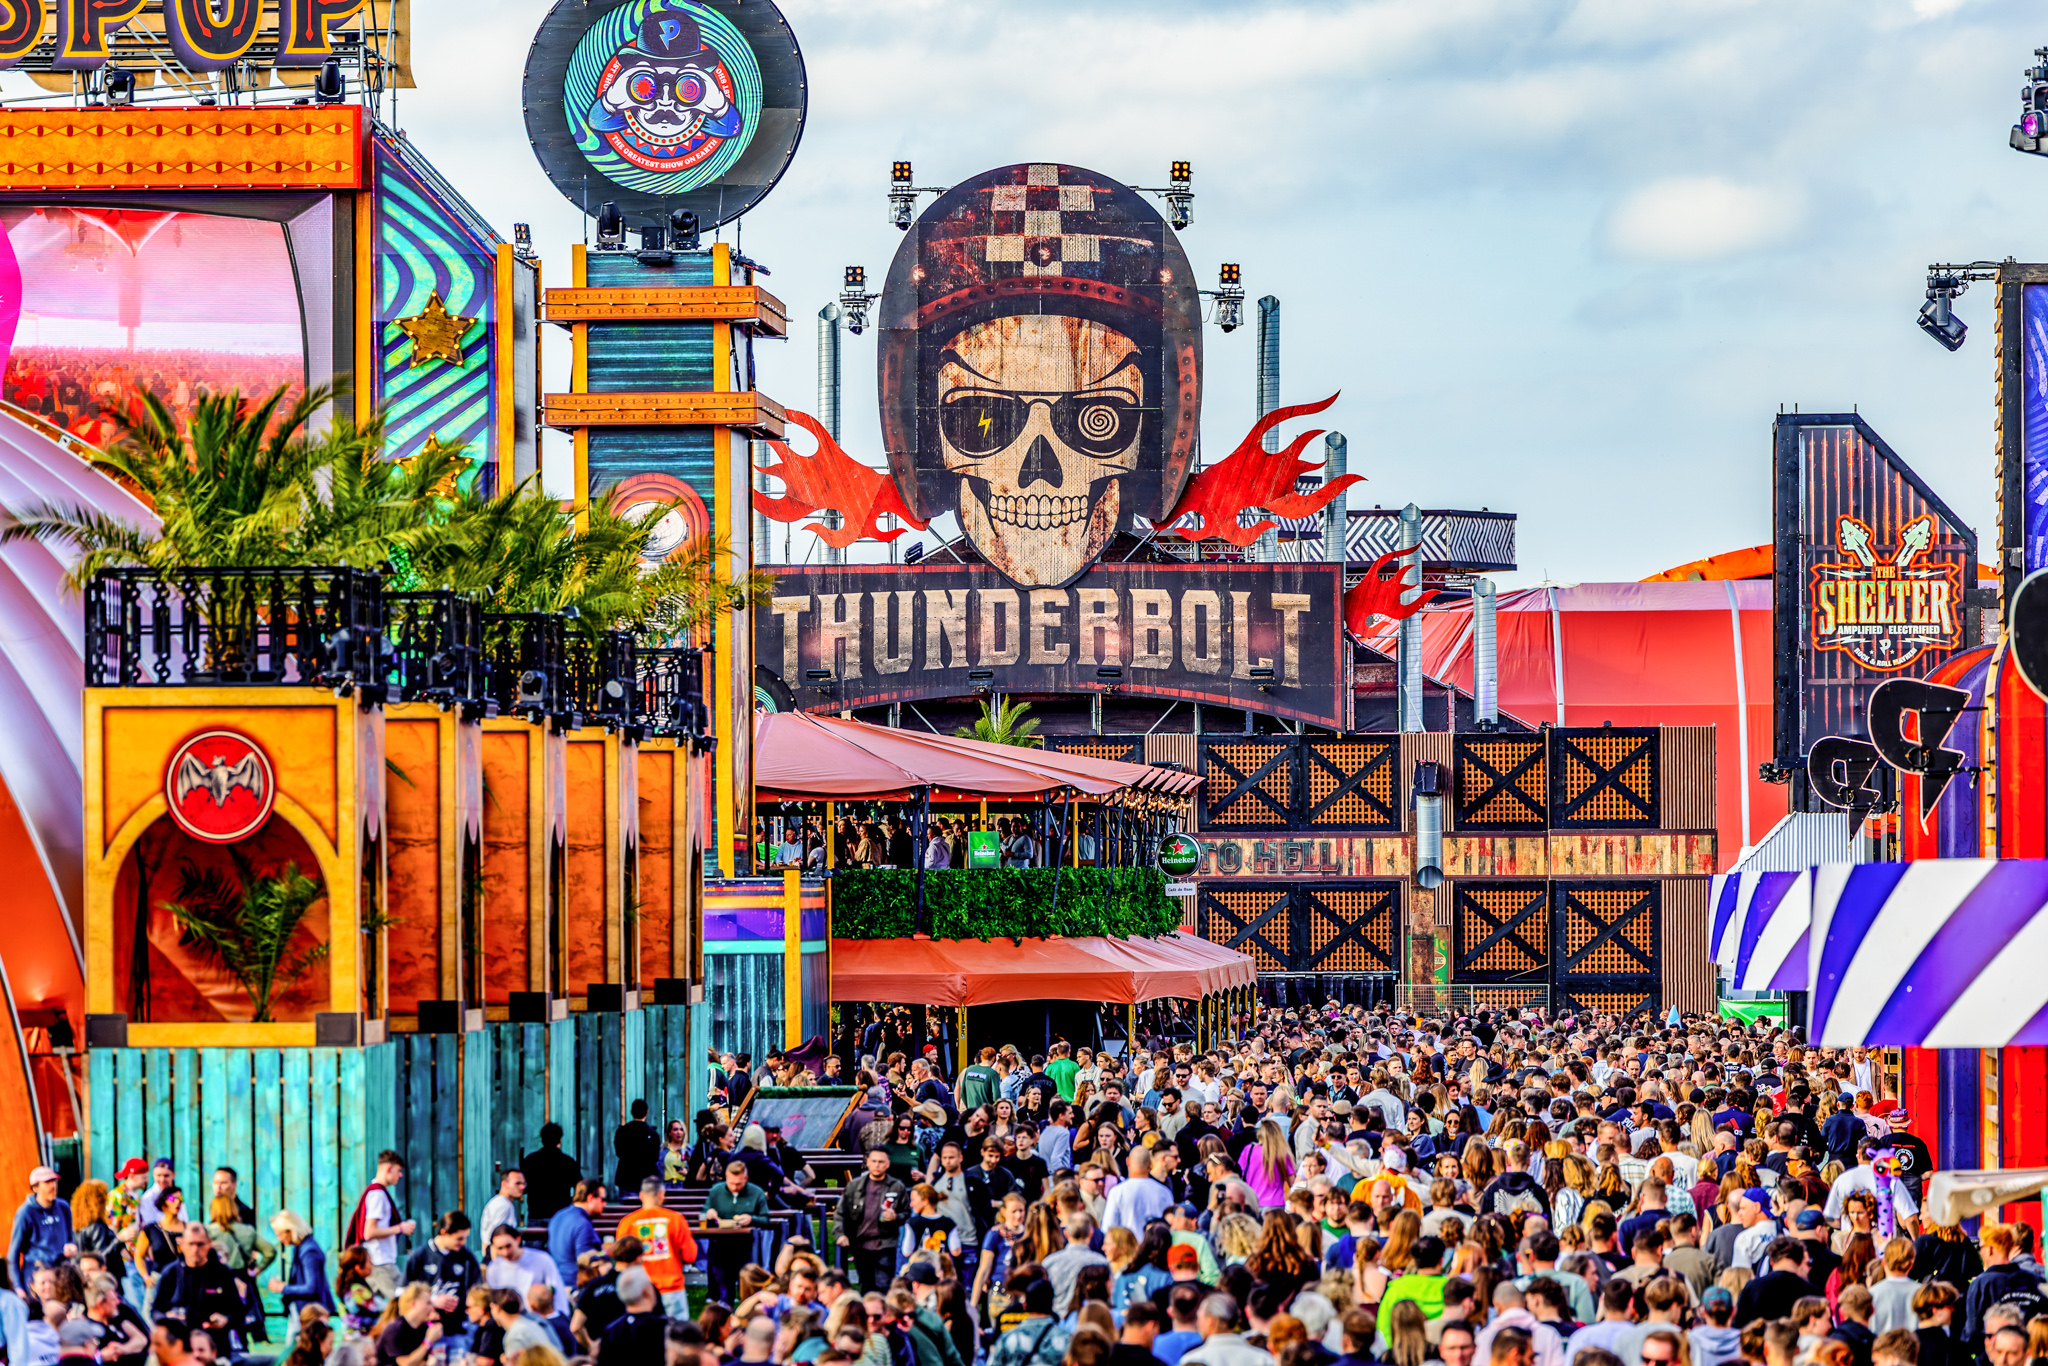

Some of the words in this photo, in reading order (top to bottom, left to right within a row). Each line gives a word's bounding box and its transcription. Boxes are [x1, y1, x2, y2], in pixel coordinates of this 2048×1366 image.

[611, 134, 625, 150] THE
[623, 148, 659, 169] GREATEST
[660, 161, 684, 169] SHOW
[684, 156, 697, 165] ON
[696, 139, 718, 160] EARTH
[1875, 565, 1896, 579] THE
[1819, 580, 1954, 635] SHELTER
[771, 588, 1311, 690] THUNDERBOLT
[1837, 625, 1883, 635] AMPLIFIED
[1888, 625, 1940, 635] ELECTRIFIED
[1854, 647, 1870, 662] ROCK
[1892, 647, 1918, 666] MAYHEM
[1200, 842, 1242, 873] TO
[1253, 842, 1340, 873] HELL
